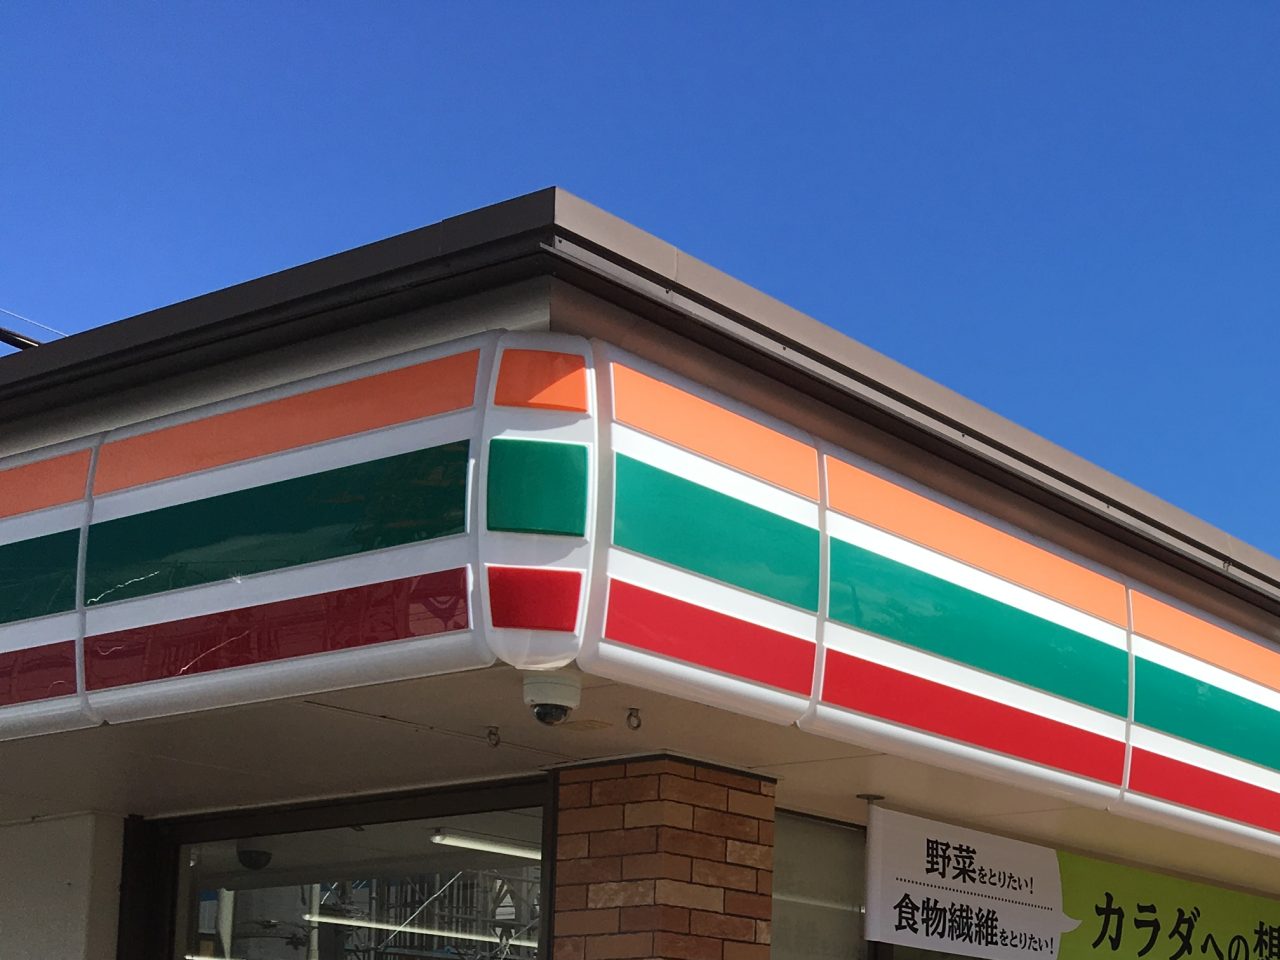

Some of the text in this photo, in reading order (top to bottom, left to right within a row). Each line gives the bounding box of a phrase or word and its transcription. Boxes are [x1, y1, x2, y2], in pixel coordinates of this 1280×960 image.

[926, 838, 1034, 894] 野菜をとりたい!
[894, 893, 1054, 954] 食物繊維をとりたい!
